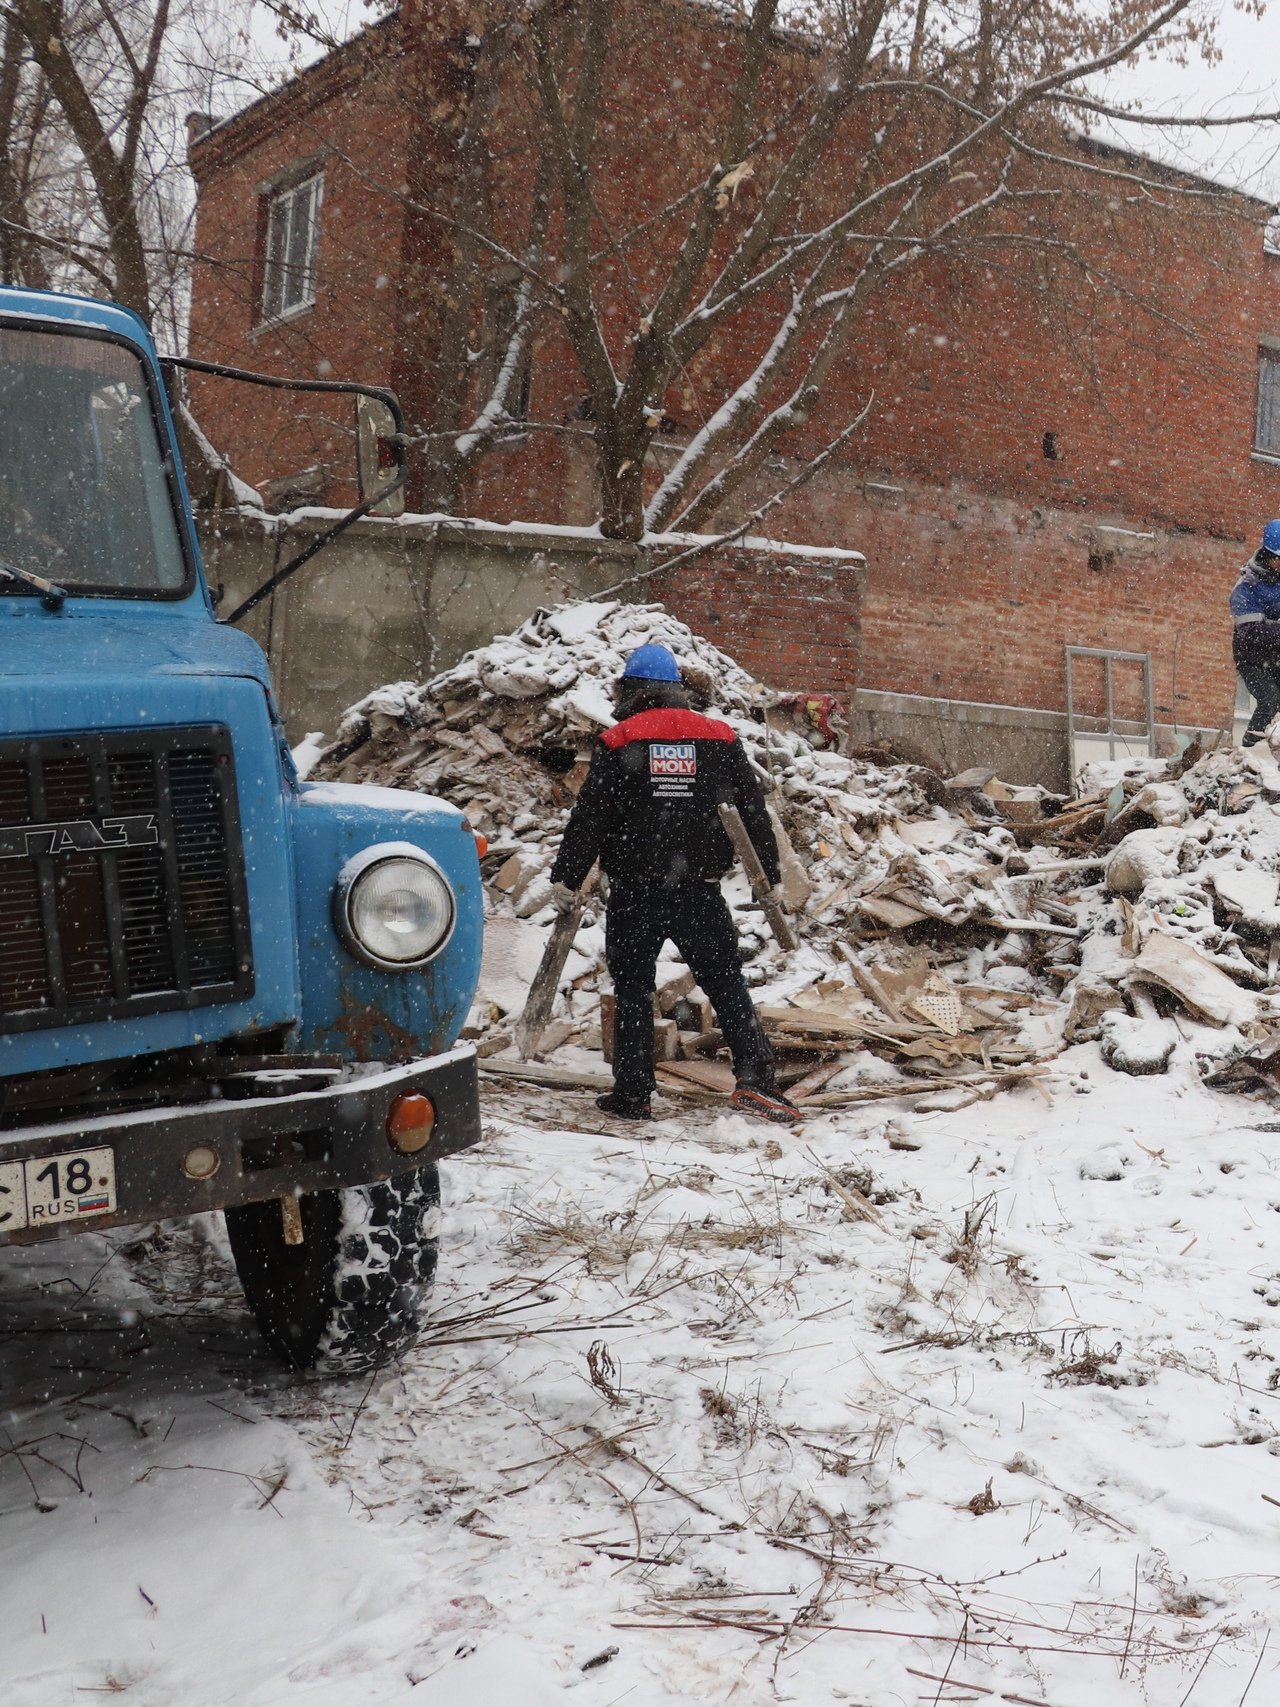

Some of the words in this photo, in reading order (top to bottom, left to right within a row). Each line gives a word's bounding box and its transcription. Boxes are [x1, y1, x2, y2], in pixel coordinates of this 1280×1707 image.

[652, 746, 693, 759] LIQUI
[653, 760, 694, 772] MOLY
[36, 1158, 92, 1199] 18
[33, 1200, 75, 1219] RUS
